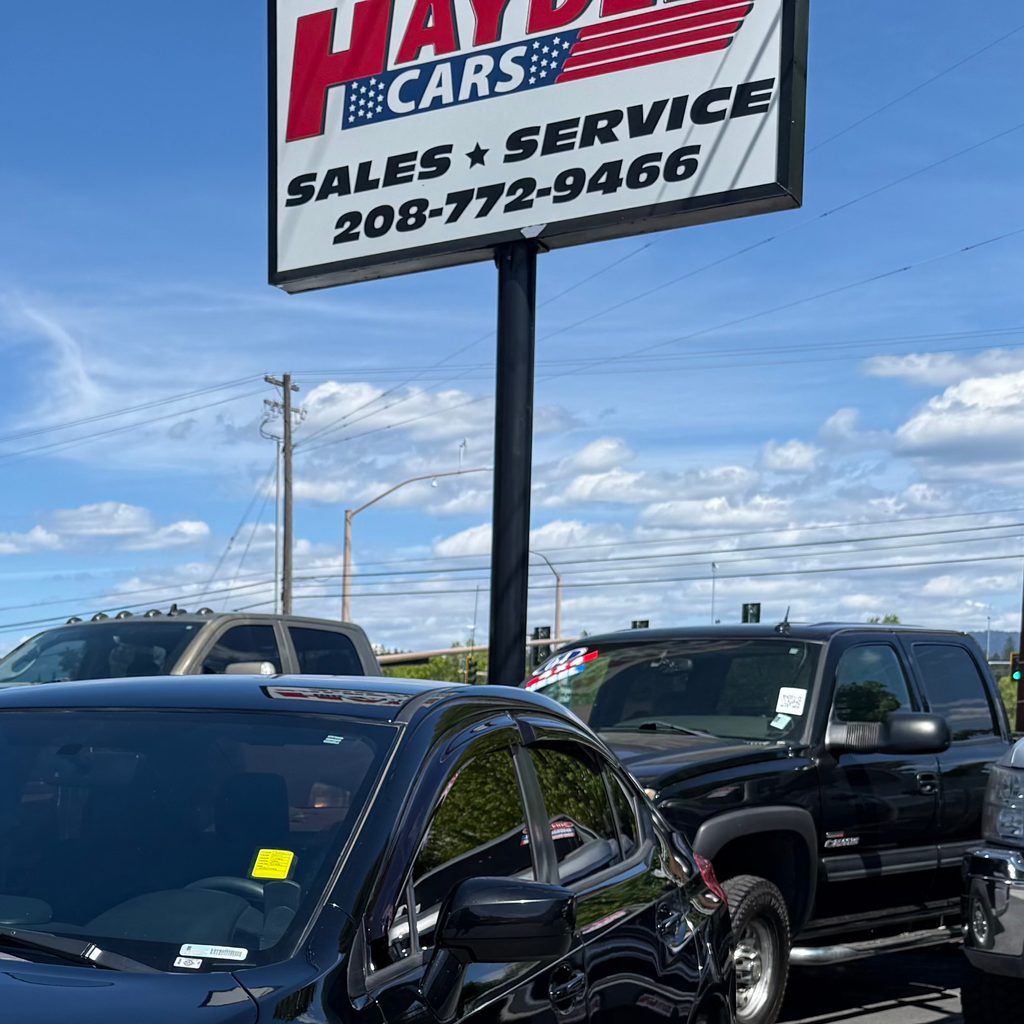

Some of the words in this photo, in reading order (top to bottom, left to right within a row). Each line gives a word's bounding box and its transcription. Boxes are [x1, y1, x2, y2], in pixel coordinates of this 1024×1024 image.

[285, 0, 688, 142] HAY
[387, 46, 527, 114] CARS
[285, 143, 453, 207] SALES
[503, 78, 775, 163] SERVICE
[332, 145, 701, 244] 208-772-9466
